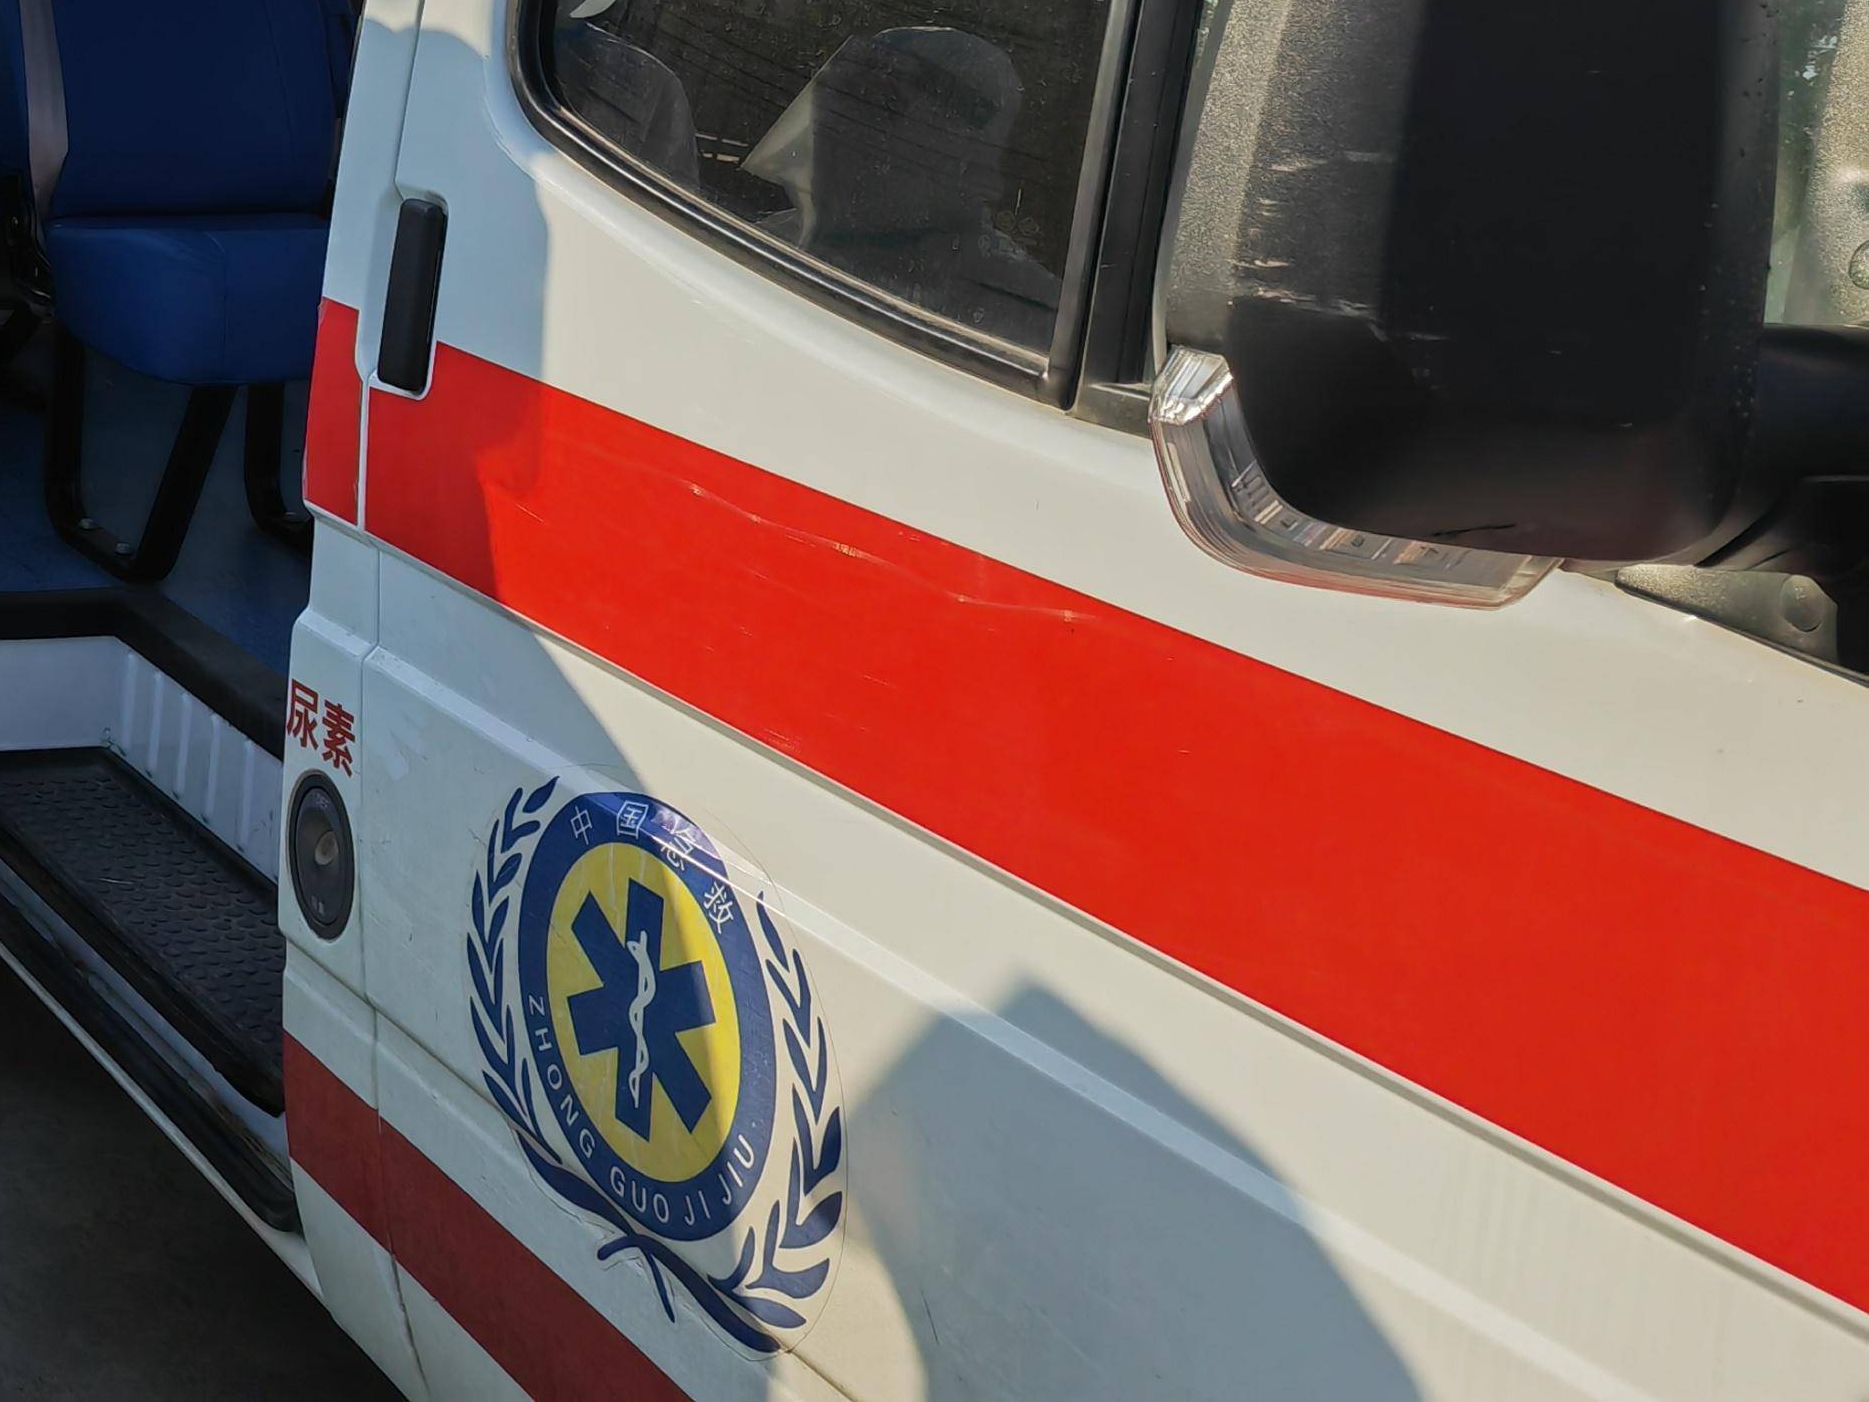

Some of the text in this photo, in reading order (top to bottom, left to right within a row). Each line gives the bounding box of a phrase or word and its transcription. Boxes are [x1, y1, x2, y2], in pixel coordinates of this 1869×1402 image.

[286, 678, 356, 778] 尿素
[570, 800, 733, 934] 中国急救
[528, 994, 755, 1226] ZHONG GUO JI JIU
